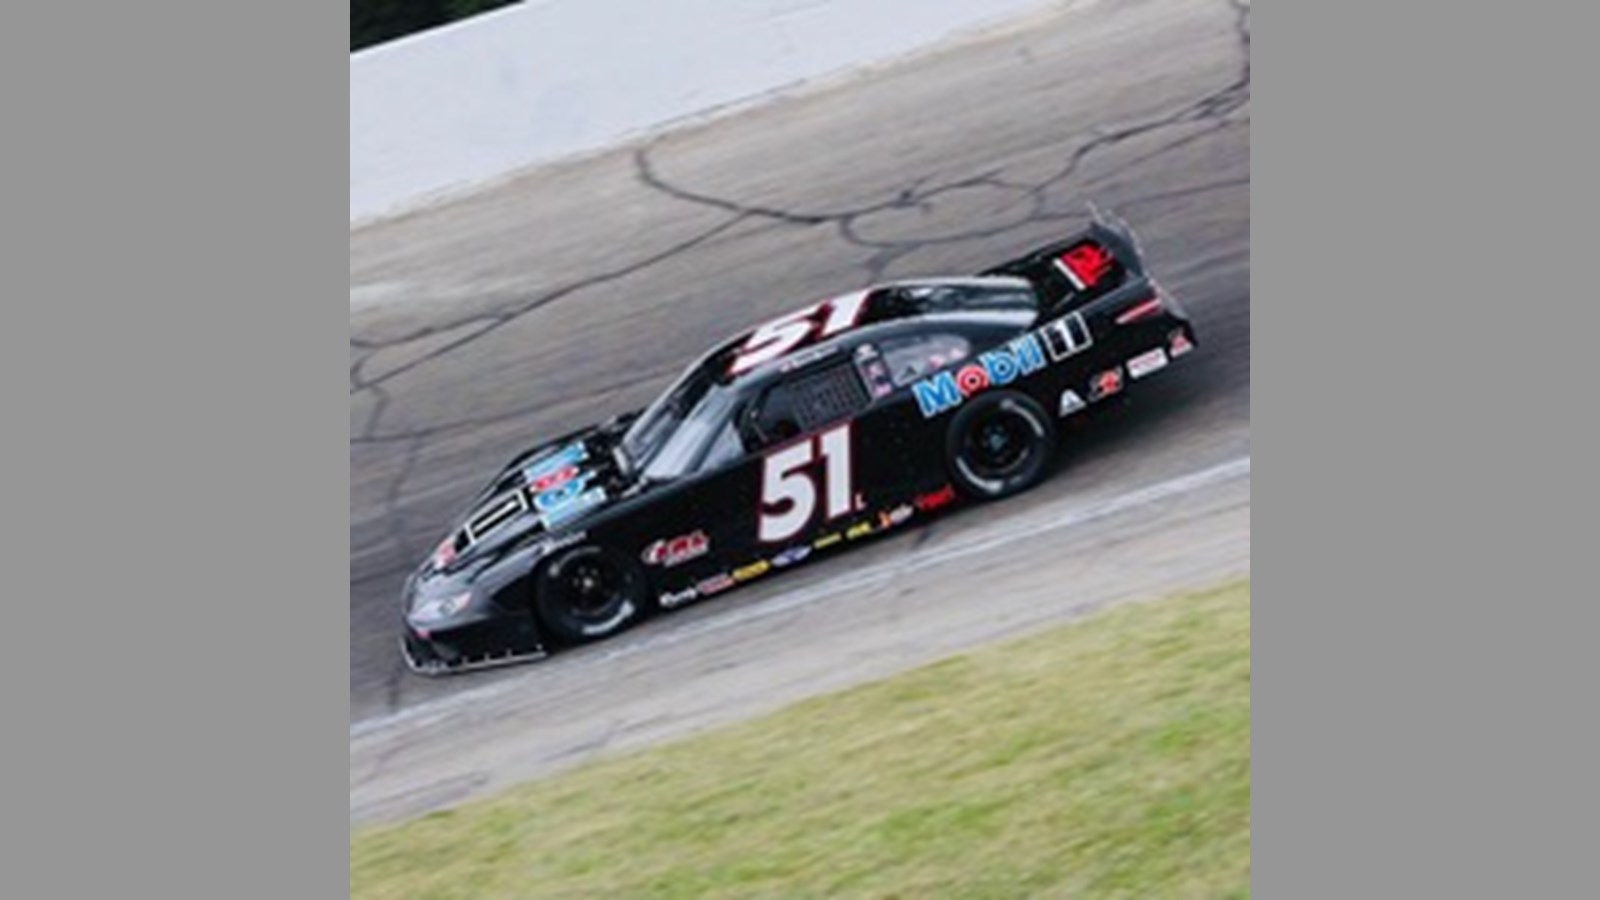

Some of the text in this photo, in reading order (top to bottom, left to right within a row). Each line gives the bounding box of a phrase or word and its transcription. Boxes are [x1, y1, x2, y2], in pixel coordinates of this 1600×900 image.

[729, 288, 870, 376] 51
[911, 333, 1048, 420] Mobil
[757, 423, 852, 542] 51
